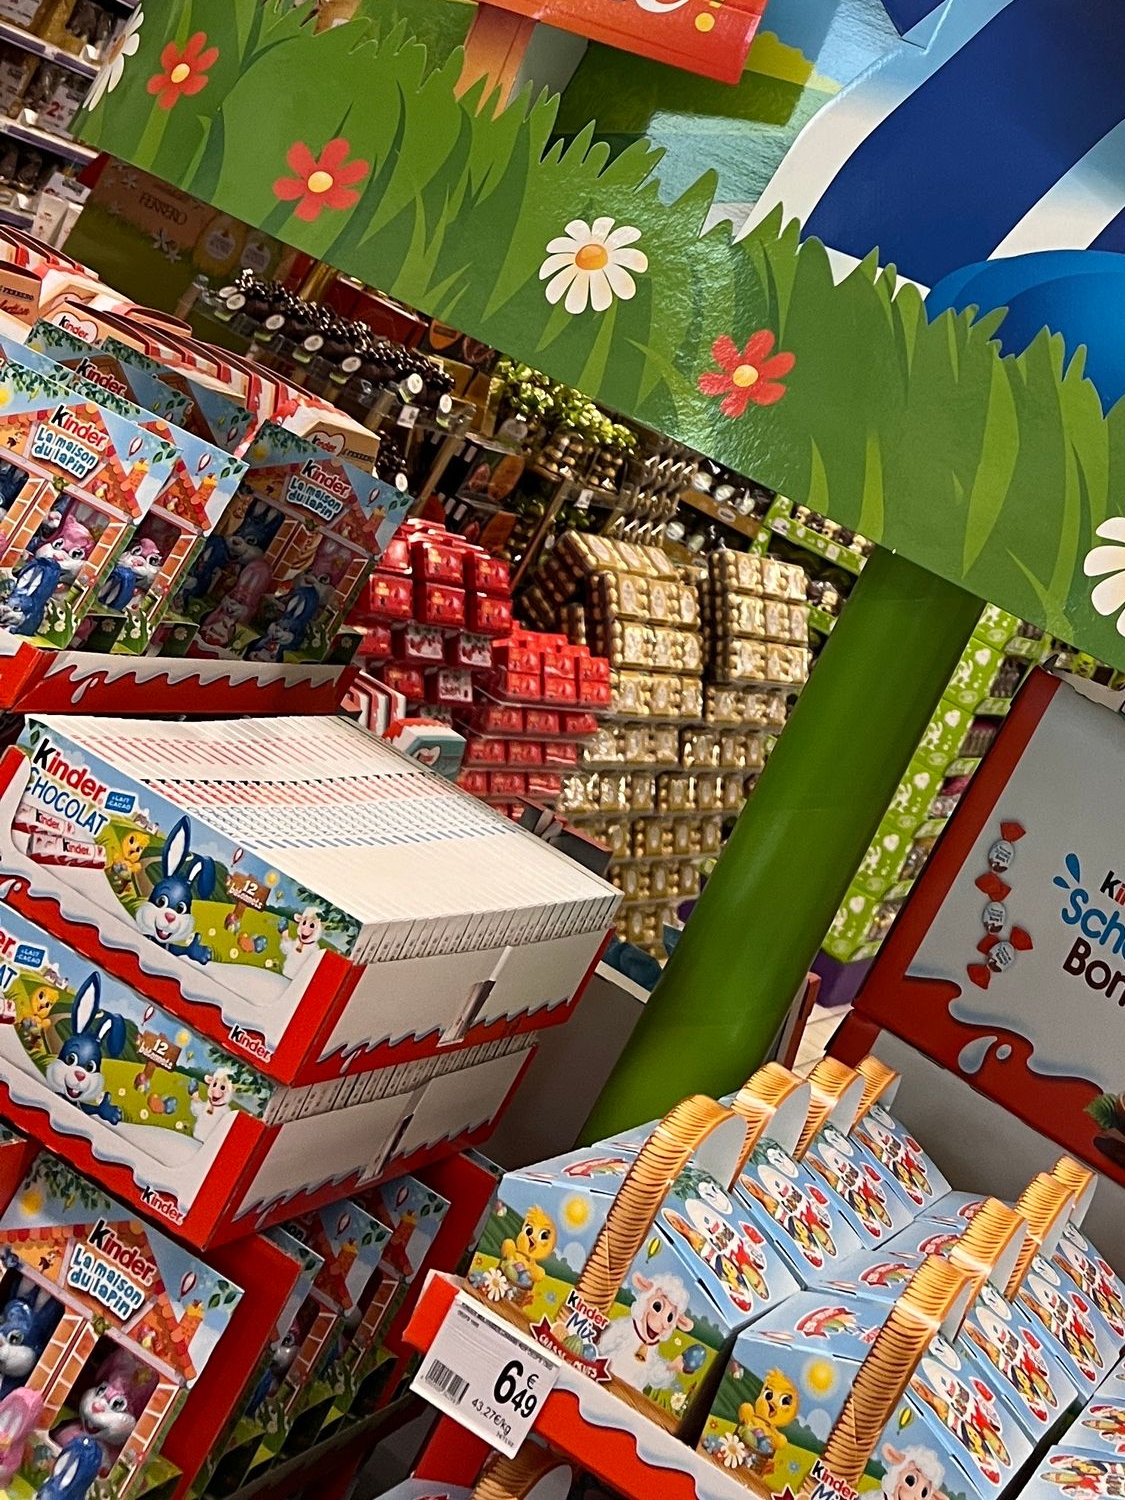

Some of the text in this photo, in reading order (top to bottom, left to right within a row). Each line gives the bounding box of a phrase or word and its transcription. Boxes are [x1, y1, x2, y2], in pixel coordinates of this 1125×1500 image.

[138, 192, 188, 227] FERRERO
[58, 315, 90, 339] Kinder
[75, 357, 127, 398] Kinder
[50, 404, 108, 449] Kinder
[34, 444, 51, 458] du
[37, 427, 97, 466] La maison
[287, 490, 304, 503] du
[301, 459, 351, 498] Kinder
[306, 483, 342, 512] maison
[32, 738, 108, 803] Kinder
[25, 766, 109, 836] CHOCOLAT
[62, 837, 91, 856] Kinder
[243, 880, 259, 897] 12
[153, 1039, 169, 1056] 12
[230, 1024, 272, 1062] Kinder
[141, 1185, 184, 1222] Kinder
[88, 1218, 155, 1281] Kinder
[70, 1268, 92, 1288] du
[72, 1247, 143, 1306] La maison
[566, 1290, 609, 1328] Kinder
[565, 1313, 596, 1343] Mix
[811, 1459, 859, 1500] Kinder
